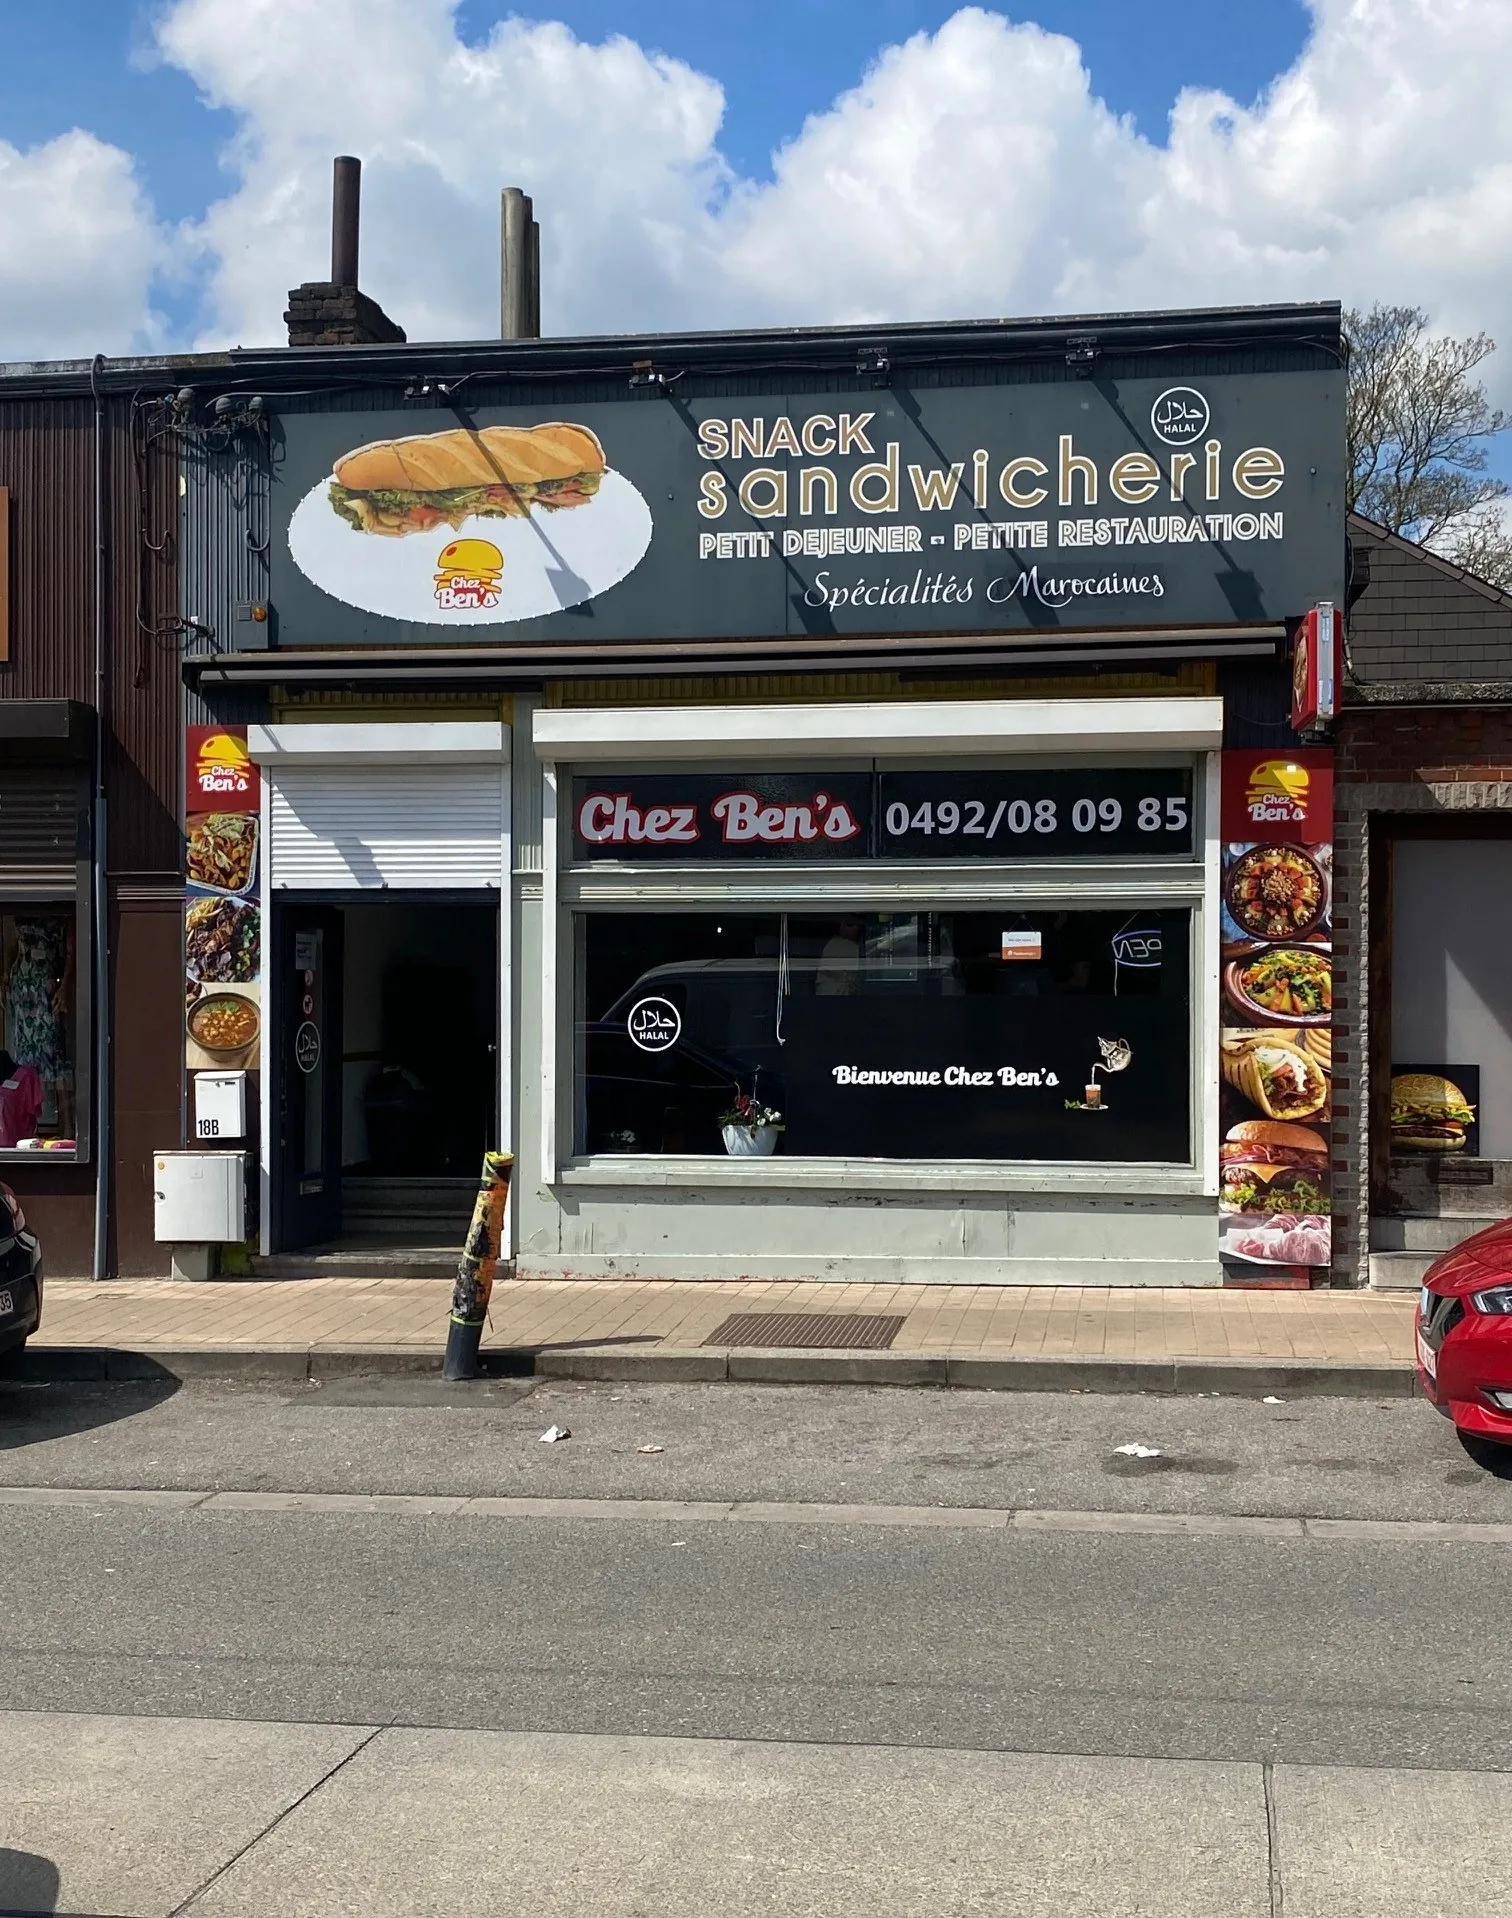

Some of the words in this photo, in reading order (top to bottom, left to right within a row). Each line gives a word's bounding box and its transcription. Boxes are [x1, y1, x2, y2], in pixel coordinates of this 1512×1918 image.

[1157, 400, 1204, 424] حلال
[697, 412, 876, 461] SNACK
[1163, 423, 1197, 434] HALAL
[697, 434, 1286, 519] sandwicherie
[699, 531, 775, 559] PETIT
[783, 525, 924, 559] DEJEUNER
[954, 520, 1049, 551] PETITE
[1058, 512, 1285, 547] RESTAURATION
[451, 575, 481, 589] Chez
[804, 568, 974, 613] Spécialités
[986, 565, 1166, 608] Marocaines
[434, 586, 499, 610] Ben's
[211, 765, 236, 776] Chez
[198, 773, 249, 792] Ben's
[1262, 793, 1291, 805] Chez
[578, 793, 700, 843] Chez
[712, 791, 860, 842] Ben's
[885, 799, 1059, 839] 0492/08
[1071, 798, 1123, 833] 09
[1136, 796, 1189, 832] 85
[1247, 803, 1307, 821] Ben's
[633, 1009, 676, 1031] حلال
[639, 1031, 670, 1040] HALAL
[831, 1065, 942, 1086] Bienvenue
[943, 1066, 995, 1086] Chez
[996, 1066, 1060, 1087] Ben's
[198, 1119, 219, 1136] 18B
